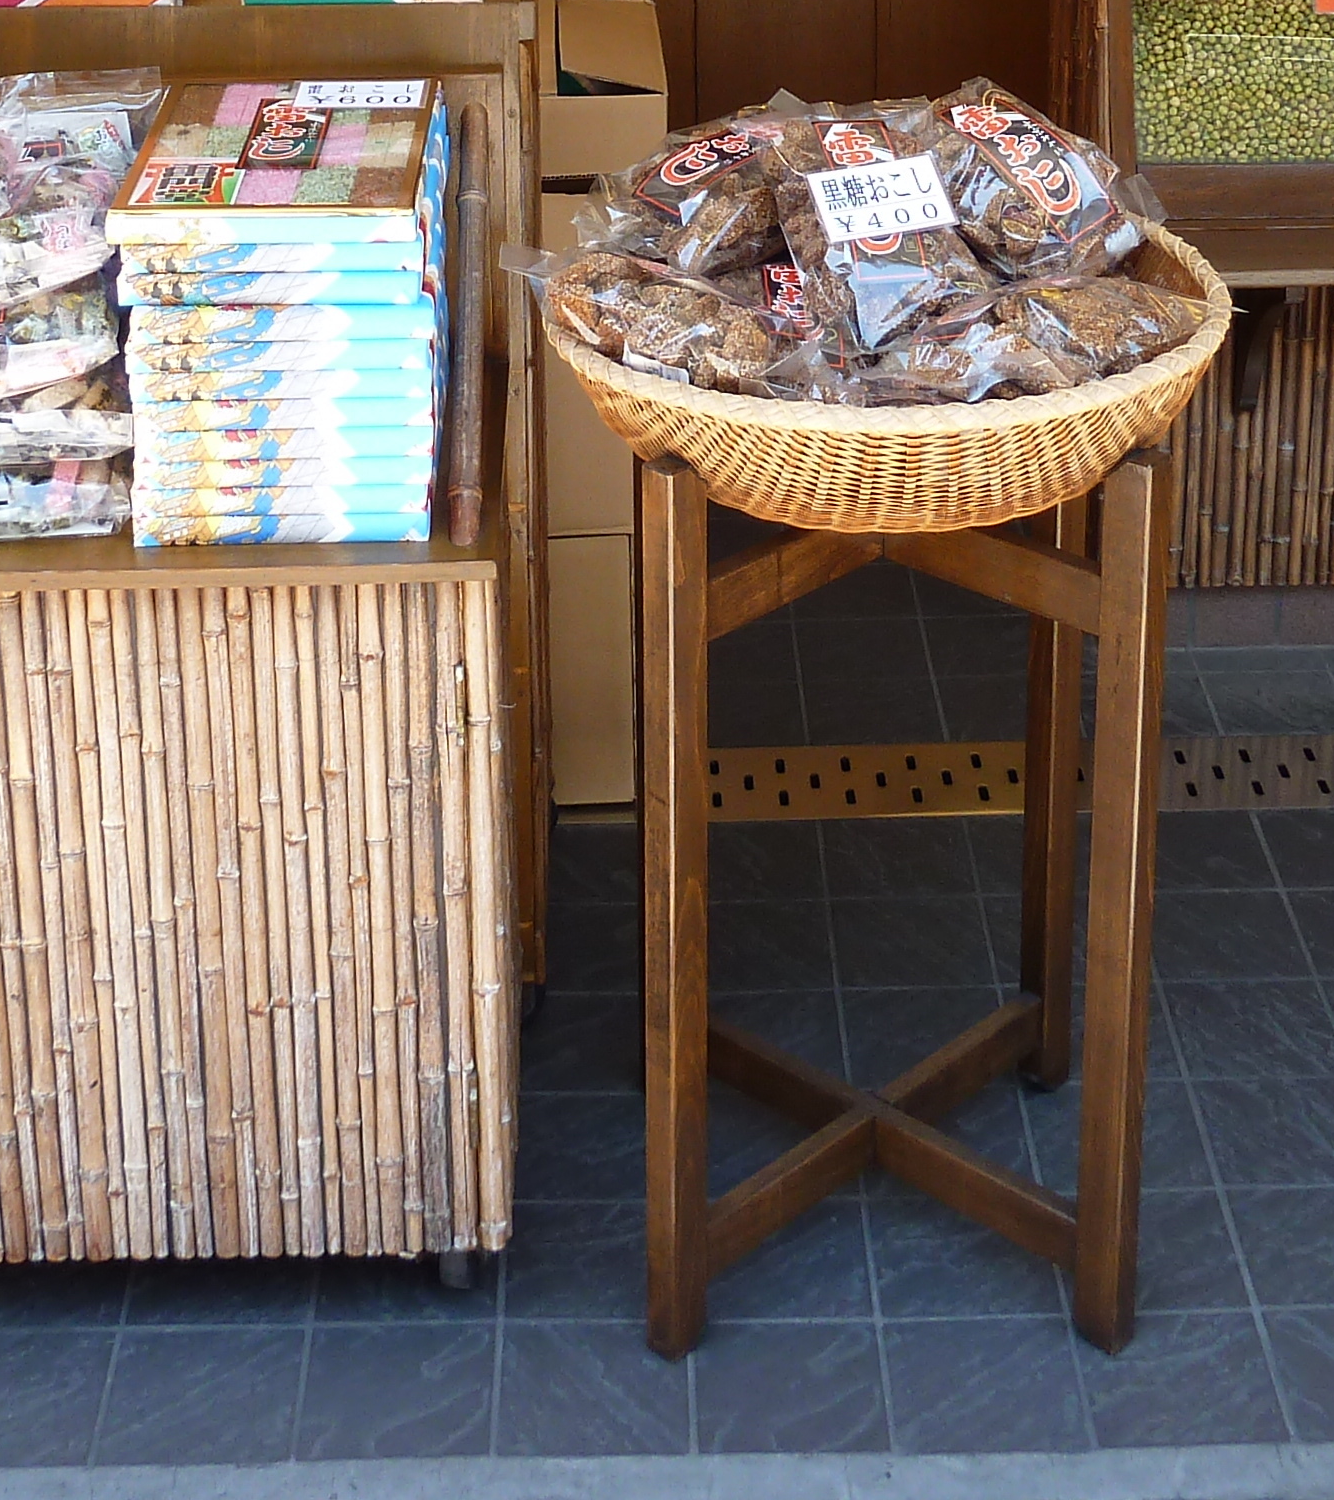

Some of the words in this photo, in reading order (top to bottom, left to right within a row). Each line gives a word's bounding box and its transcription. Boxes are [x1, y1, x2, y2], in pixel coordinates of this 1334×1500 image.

[308, 84, 418, 94] 雷おこし
[308, 96, 412, 105] ¥600
[955, 104, 1081, 216] 雷おこし
[820, 167, 933, 211] 黒糖おこし
[835, 202, 939, 234] ¥400
